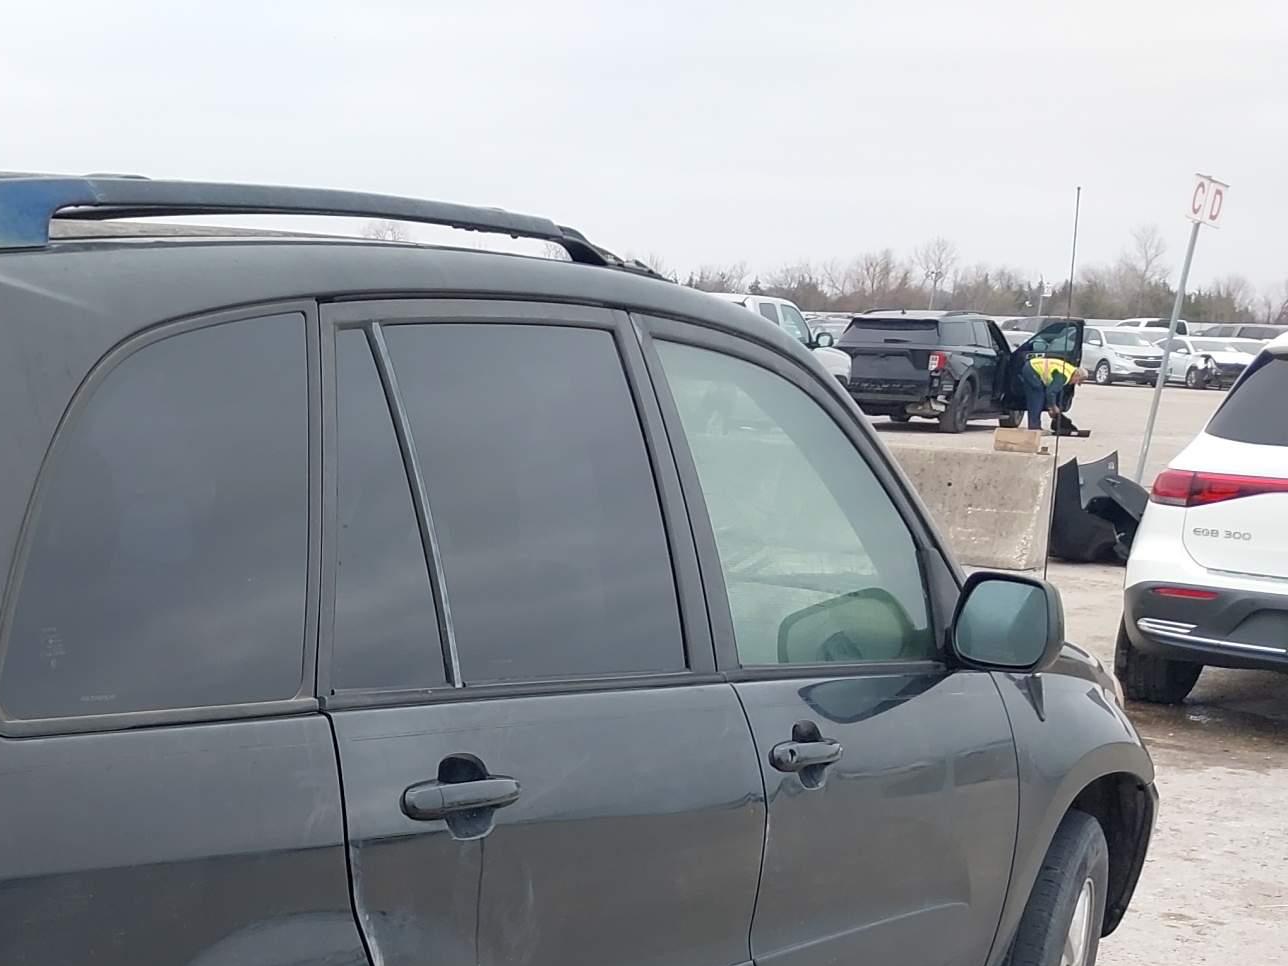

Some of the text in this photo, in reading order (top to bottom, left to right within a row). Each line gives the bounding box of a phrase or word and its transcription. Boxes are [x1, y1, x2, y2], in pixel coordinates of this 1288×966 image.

[1191, 181, 1206, 215] C
[1209, 188, 1223, 221] D
[1223, 530, 1252, 541] 300
